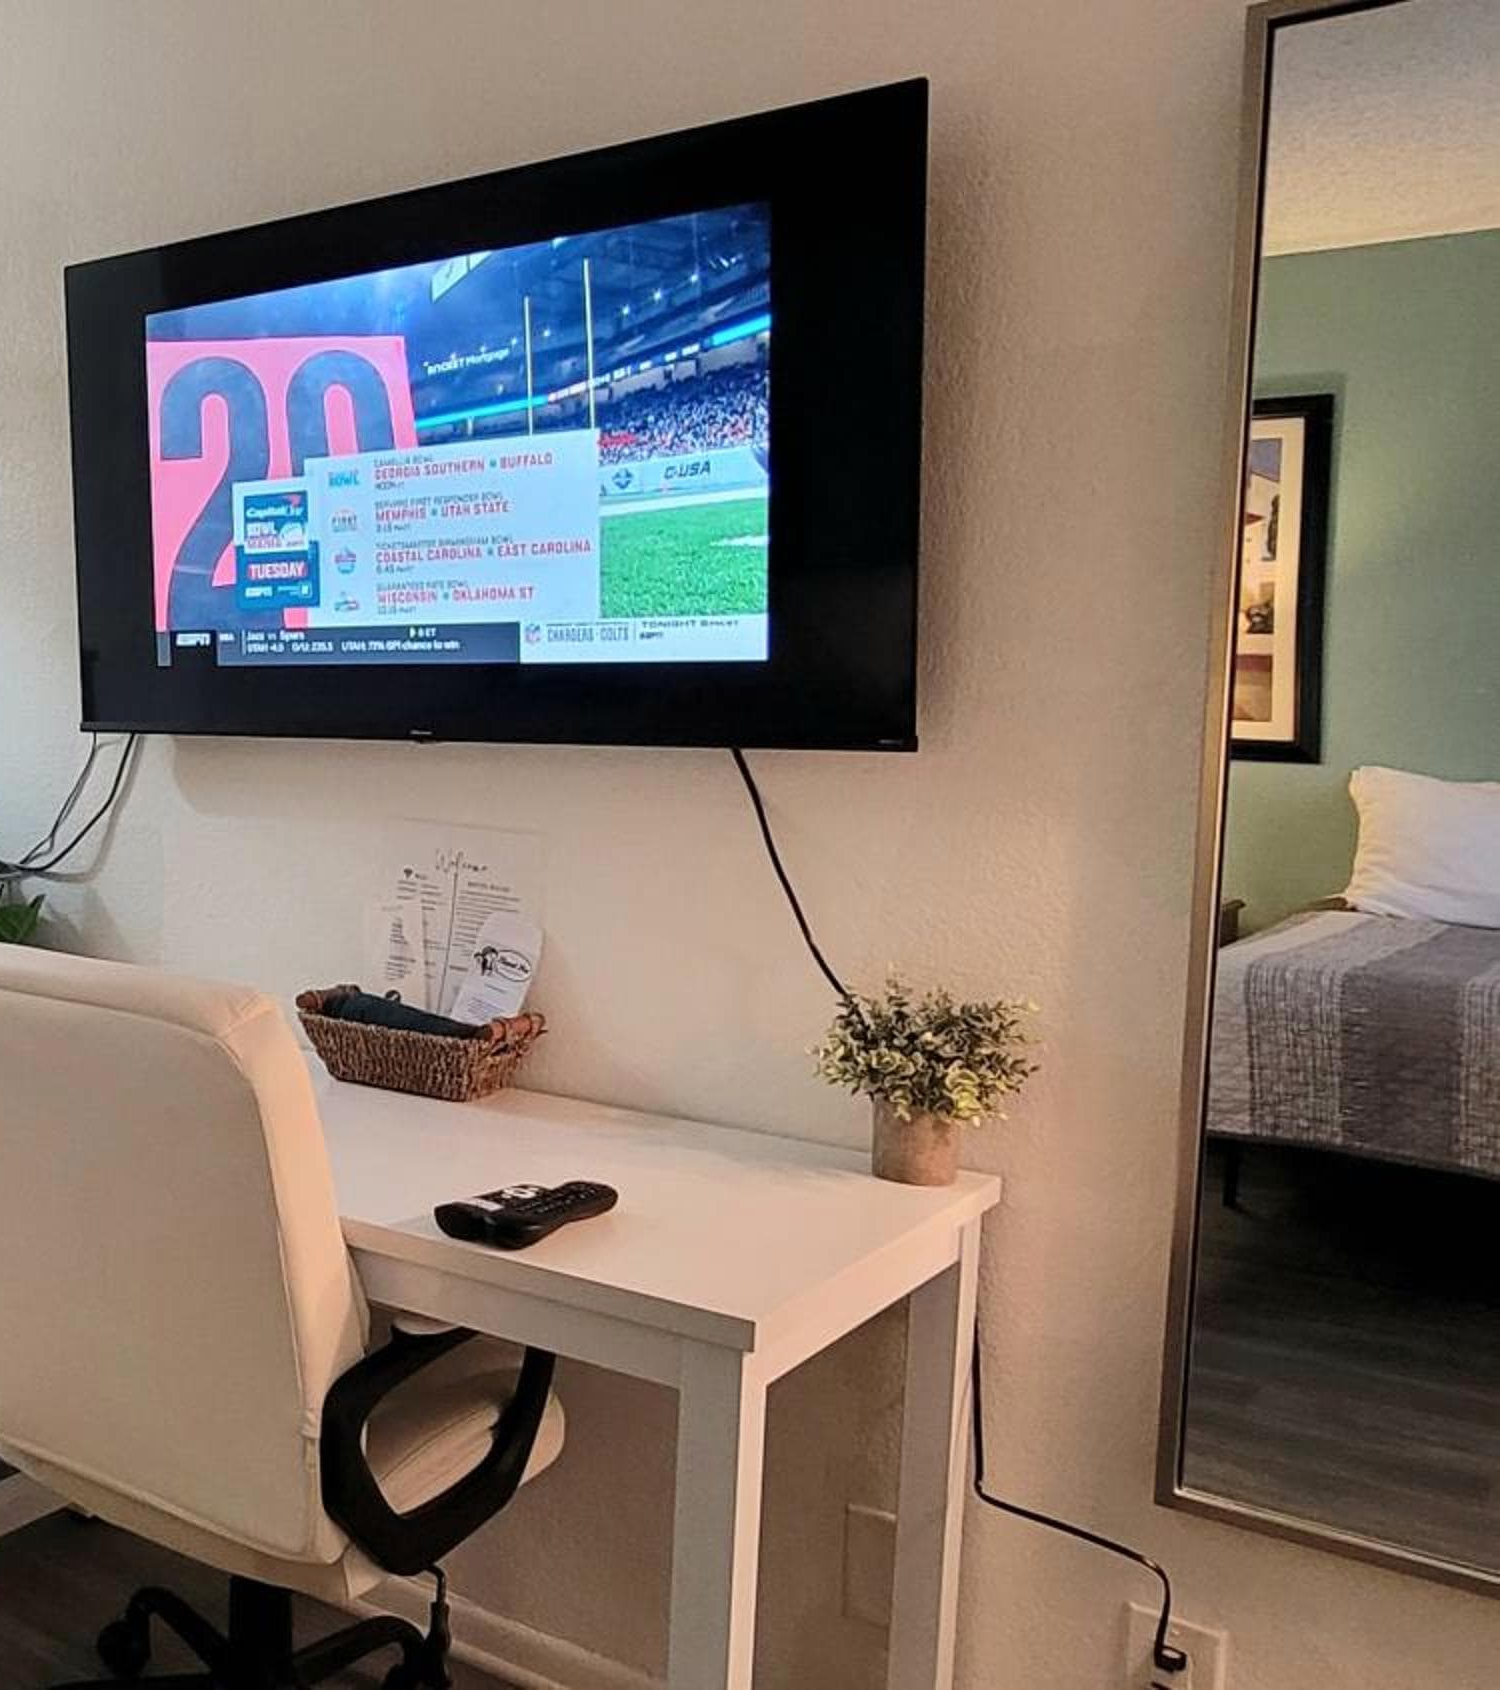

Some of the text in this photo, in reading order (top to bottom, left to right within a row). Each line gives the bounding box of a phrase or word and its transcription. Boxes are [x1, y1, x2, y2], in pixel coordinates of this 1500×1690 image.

[374, 452, 553, 481] GEORGIA SOUTHERN BUFFALO
[375, 500, 510, 522] MEMPHIS UTAH STATE
[375, 548, 423, 564] COASTAL
[427, 546, 483, 561] CAROLINA
[497, 543, 526, 557] EAST
[531, 539, 591, 555] CAROLINA
[249, 561, 306, 580] TUESDAY
[377, 586, 534, 604] WISCONSIN OKLAHOMA ST
[641, 619, 696, 629] TONIGHT
[176, 632, 211, 647] ESPN
[547, 626, 594, 642] CHARGERS
[600, 626, 629, 641] COLTS
